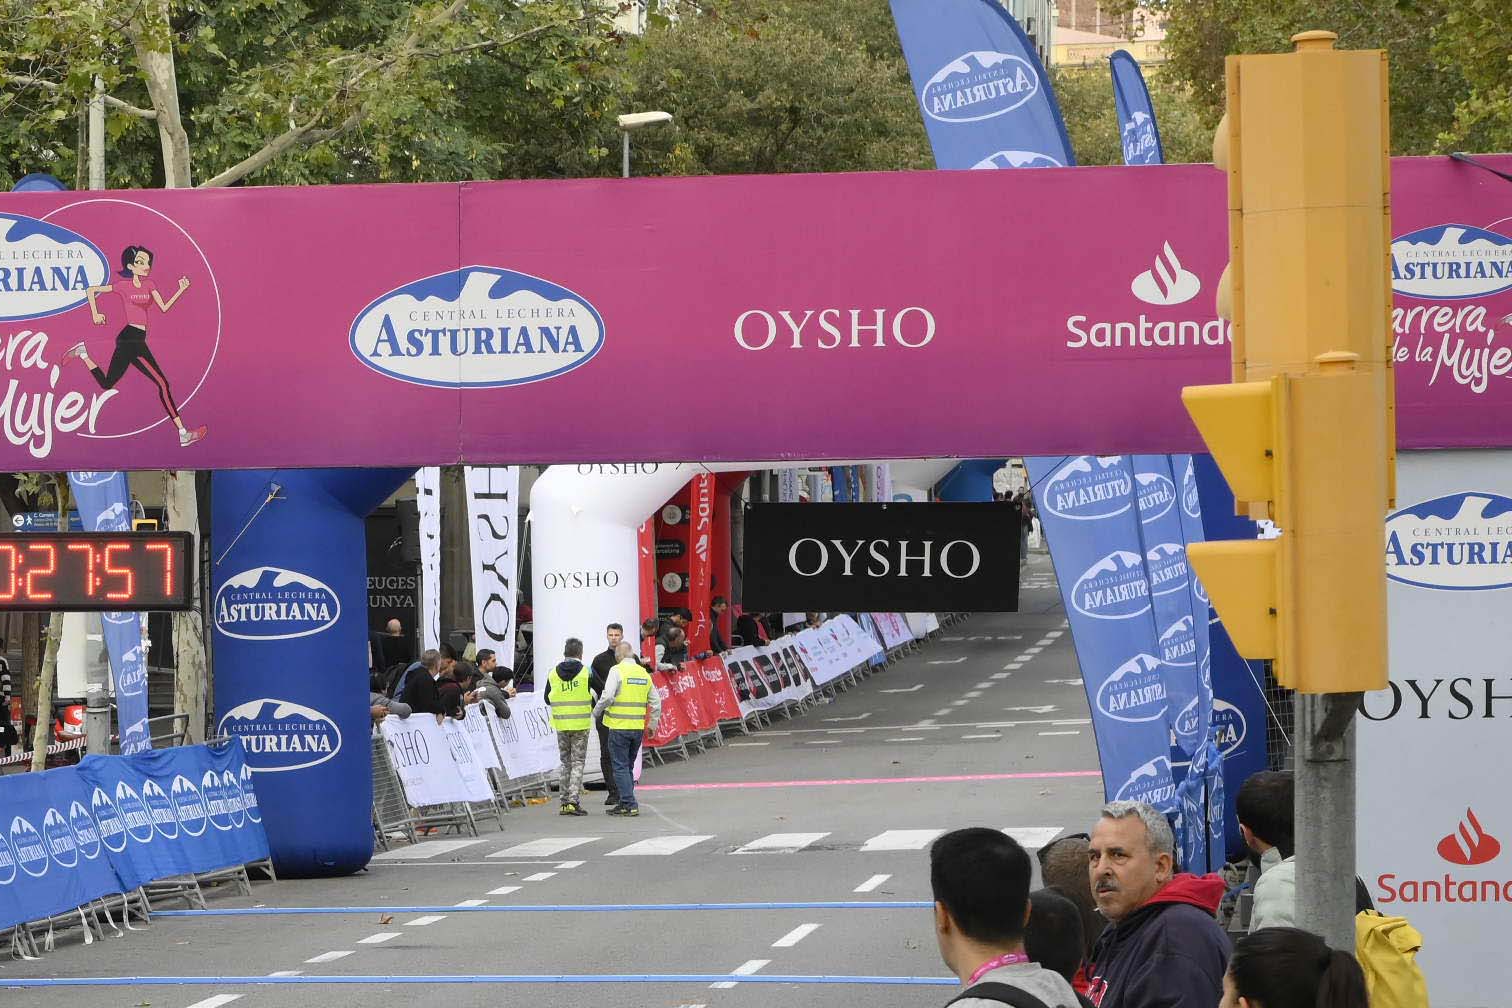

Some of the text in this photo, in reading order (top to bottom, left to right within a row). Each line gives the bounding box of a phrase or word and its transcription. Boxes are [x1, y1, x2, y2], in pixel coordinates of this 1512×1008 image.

[12, 249, 83, 261] LECHERA
[409, 305, 576, 321] CENTRAL LECHERA
[1392, 304, 1487, 334] arrera
[369, 313, 586, 358] ASTURIANA
[733, 306, 936, 351] OYSHO
[1066, 314, 1233, 348] Santand
[1428, 328, 1512, 394] Muje
[1412, 527, 1479, 537] CENTRAL
[788, 537, 981, 579] OYSHO
[366, 576, 416, 590] EUGES
[543, 570, 619, 589] OYSHO
[231, 591, 326, 600] CENTRAL LECHERA
[369, 595, 415, 608] UNYA
[218, 597, 331, 624] ASTURIANA
[561, 679, 580, 692] Life
